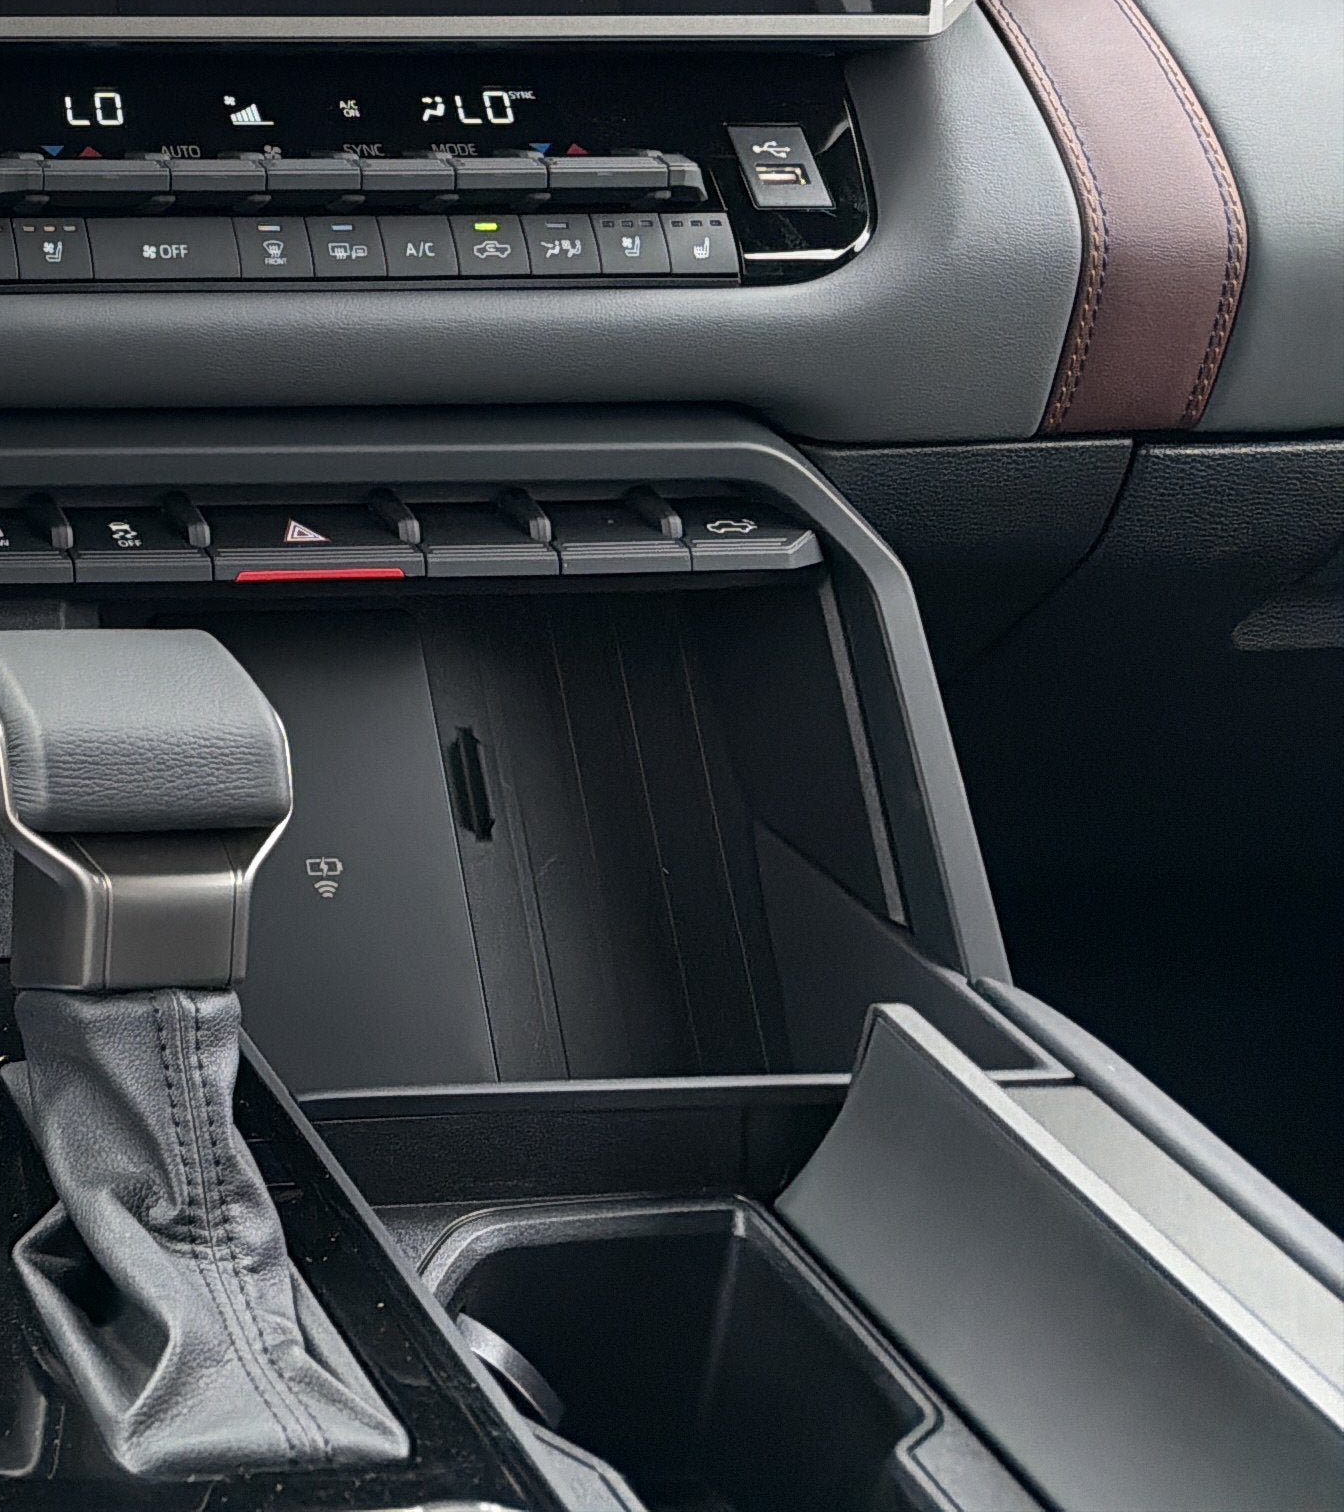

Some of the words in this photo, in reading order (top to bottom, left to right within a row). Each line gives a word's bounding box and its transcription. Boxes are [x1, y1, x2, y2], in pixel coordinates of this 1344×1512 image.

[508, 90, 537, 100] SYNC
[339, 100, 359, 110] A/C
[162, 144, 201, 159] AUTO
[343, 144, 385, 157] SYNC
[431, 143, 478, 156] MODE
[159, 244, 189, 259] OFF
[405, 242, 436, 257] A/C
[264, 257, 287, 265] FRONT
[117, 539, 143, 548] OFF
